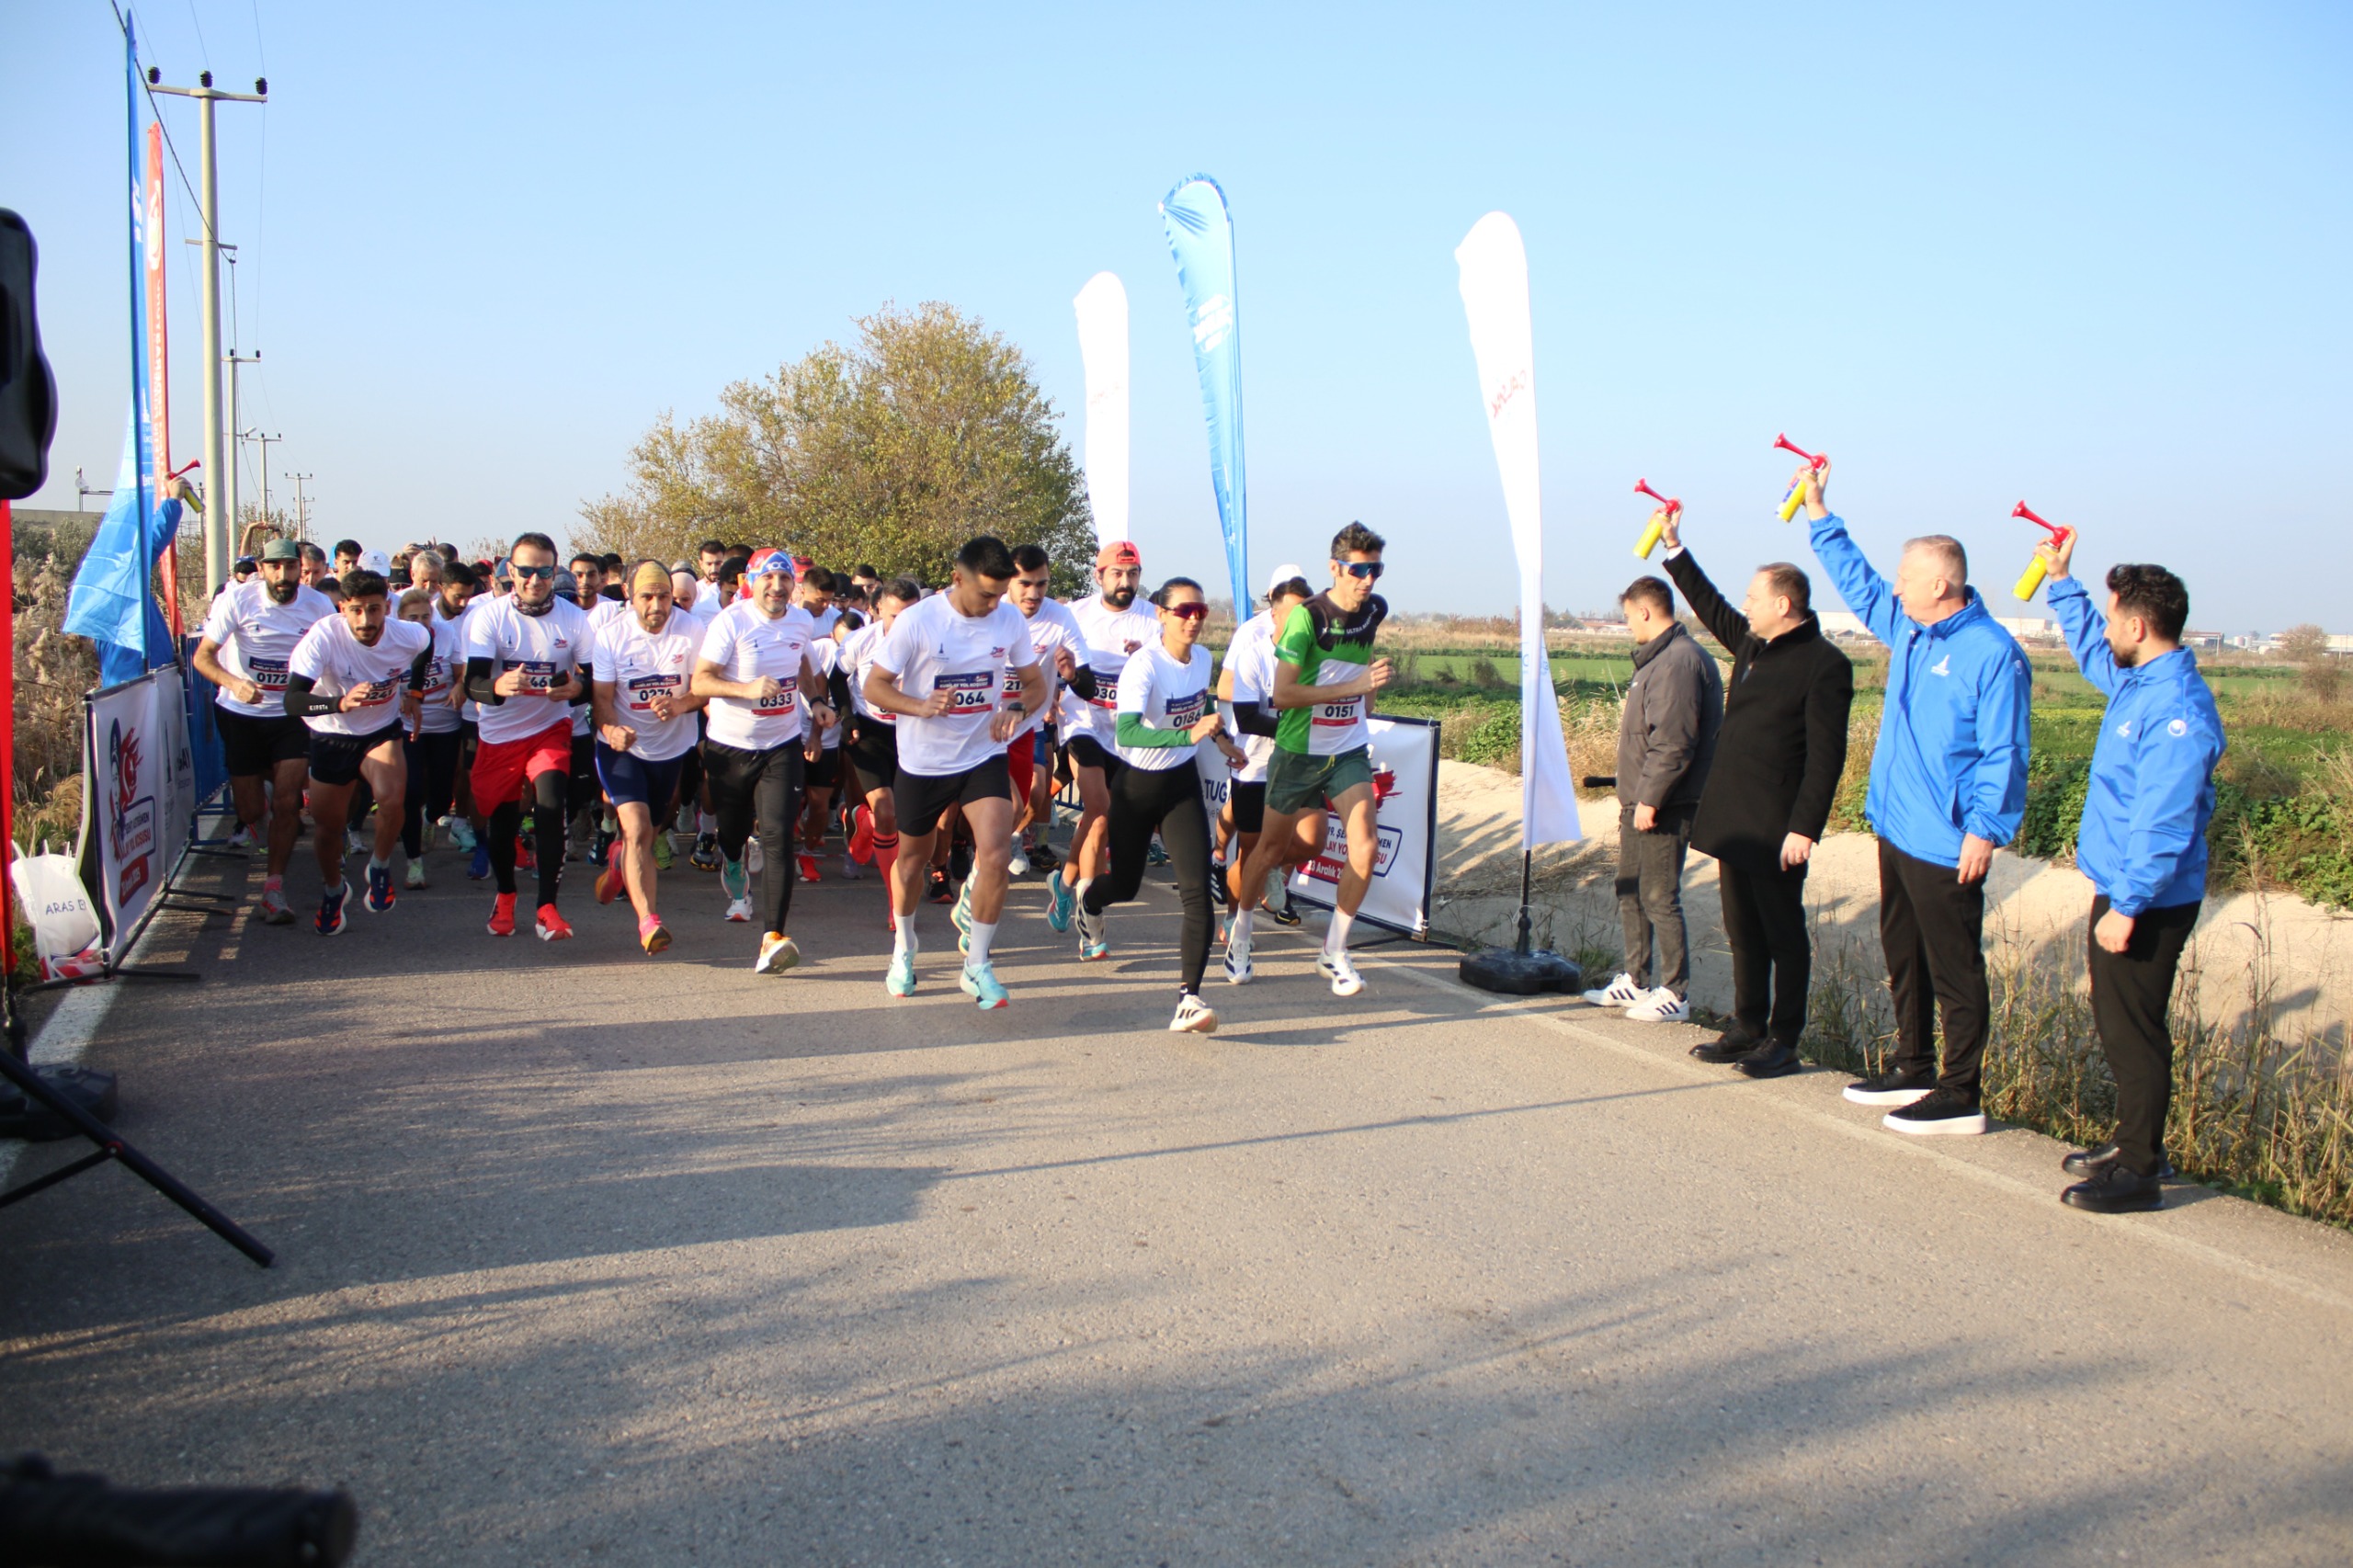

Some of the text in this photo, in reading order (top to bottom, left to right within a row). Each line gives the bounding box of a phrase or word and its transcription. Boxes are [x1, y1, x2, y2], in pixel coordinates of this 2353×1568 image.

[256, 672, 288, 684] 0172
[424, 677, 438, 688] 93
[530, 676, 548, 687] 46
[1003, 680, 1024, 691] 21
[760, 693, 792, 708] 0333
[956, 691, 985, 706] 064
[1173, 709, 1201, 727] 0186
[1324, 705, 1355, 718] 0151
[1204, 778, 1227, 803] TUG
[1336, 828, 1347, 841] ŞE
[1337, 843, 1348, 854] YO
[1378, 837, 1392, 849] MEN
[1377, 852, 1388, 865] SU
[1336, 867, 1344, 879] 2
[46, 900, 74, 915] ARAS
